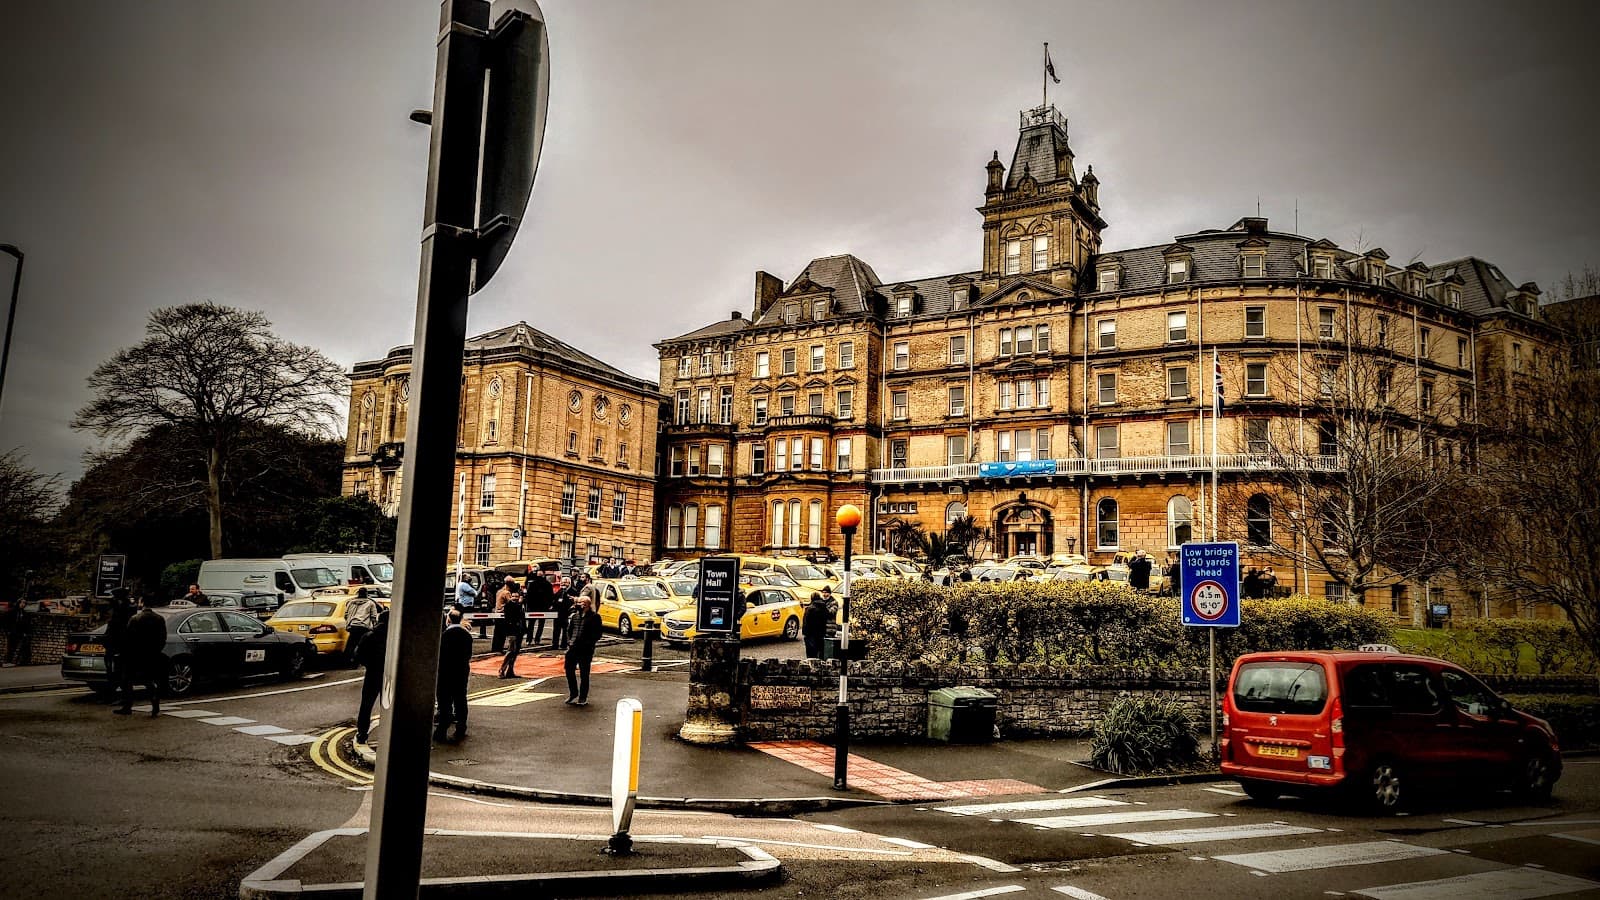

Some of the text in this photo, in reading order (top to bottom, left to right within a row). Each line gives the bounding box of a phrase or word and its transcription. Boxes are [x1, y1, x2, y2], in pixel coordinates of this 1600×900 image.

[1185, 548, 1233, 557] Low bridge
[1188, 558, 1231, 567] 130 yards
[706, 570, 727, 578] Town
[1195, 568, 1222, 576] ahead
[705, 579, 722, 587] Hall
[1199, 591, 1212, 599] 4.5
